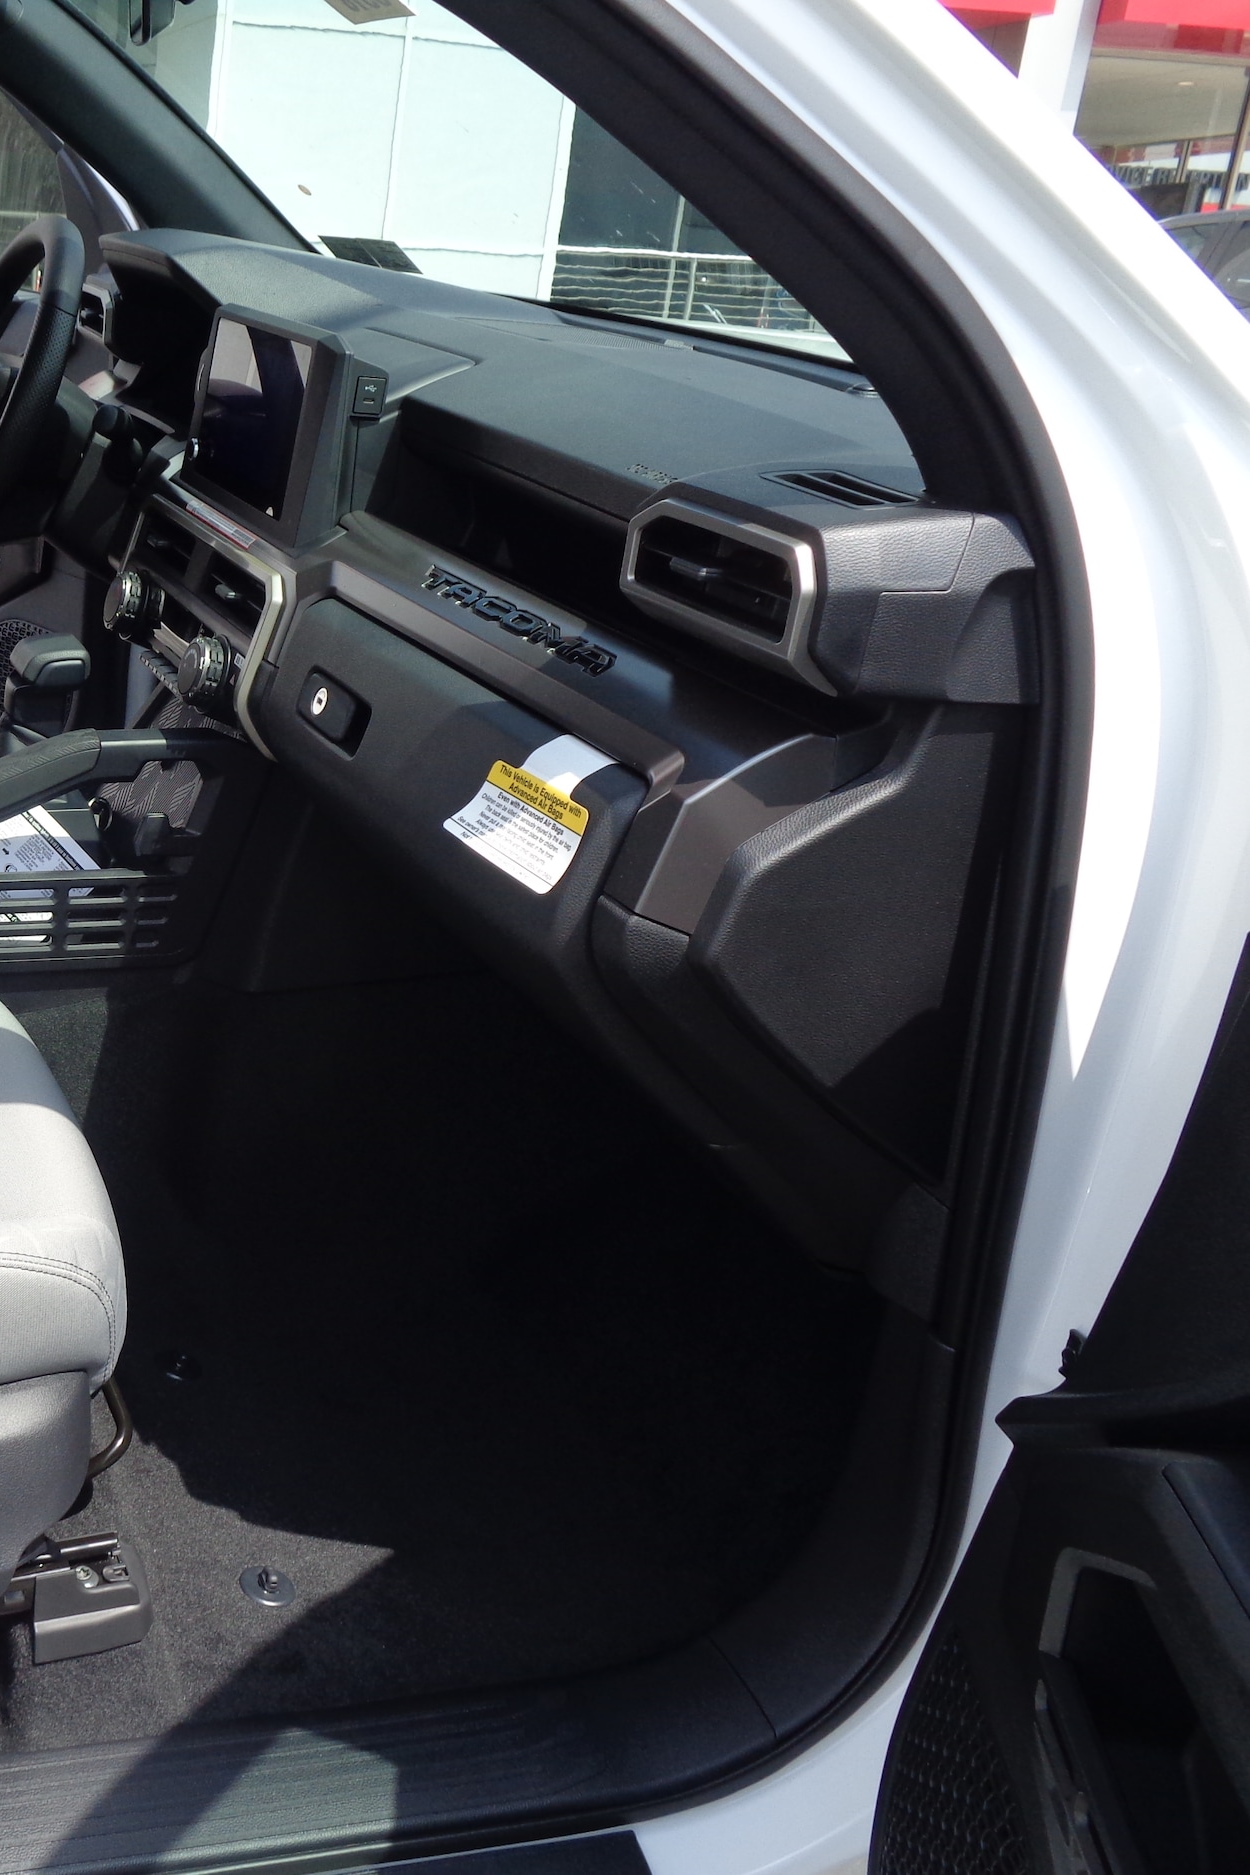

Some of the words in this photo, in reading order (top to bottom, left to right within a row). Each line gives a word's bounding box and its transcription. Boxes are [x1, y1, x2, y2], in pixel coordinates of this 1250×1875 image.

[421, 565, 617, 677] TACOMA
[482, 793, 496, 804] Children
[500, 765, 512, 776] This
[512, 772, 533, 788] Vehicle
[533, 784, 540, 792] is
[538, 788, 568, 811] Equipped
[568, 805, 582, 817] with
[509, 783, 538, 803] Advanced
[538, 800, 547, 808] Air
[546, 805, 564, 820] Bags
[498, 792, 510, 802] Even
[510, 799, 520, 808] with
[520, 805, 544, 822] Advanced
[550, 823, 564, 836] Bags
